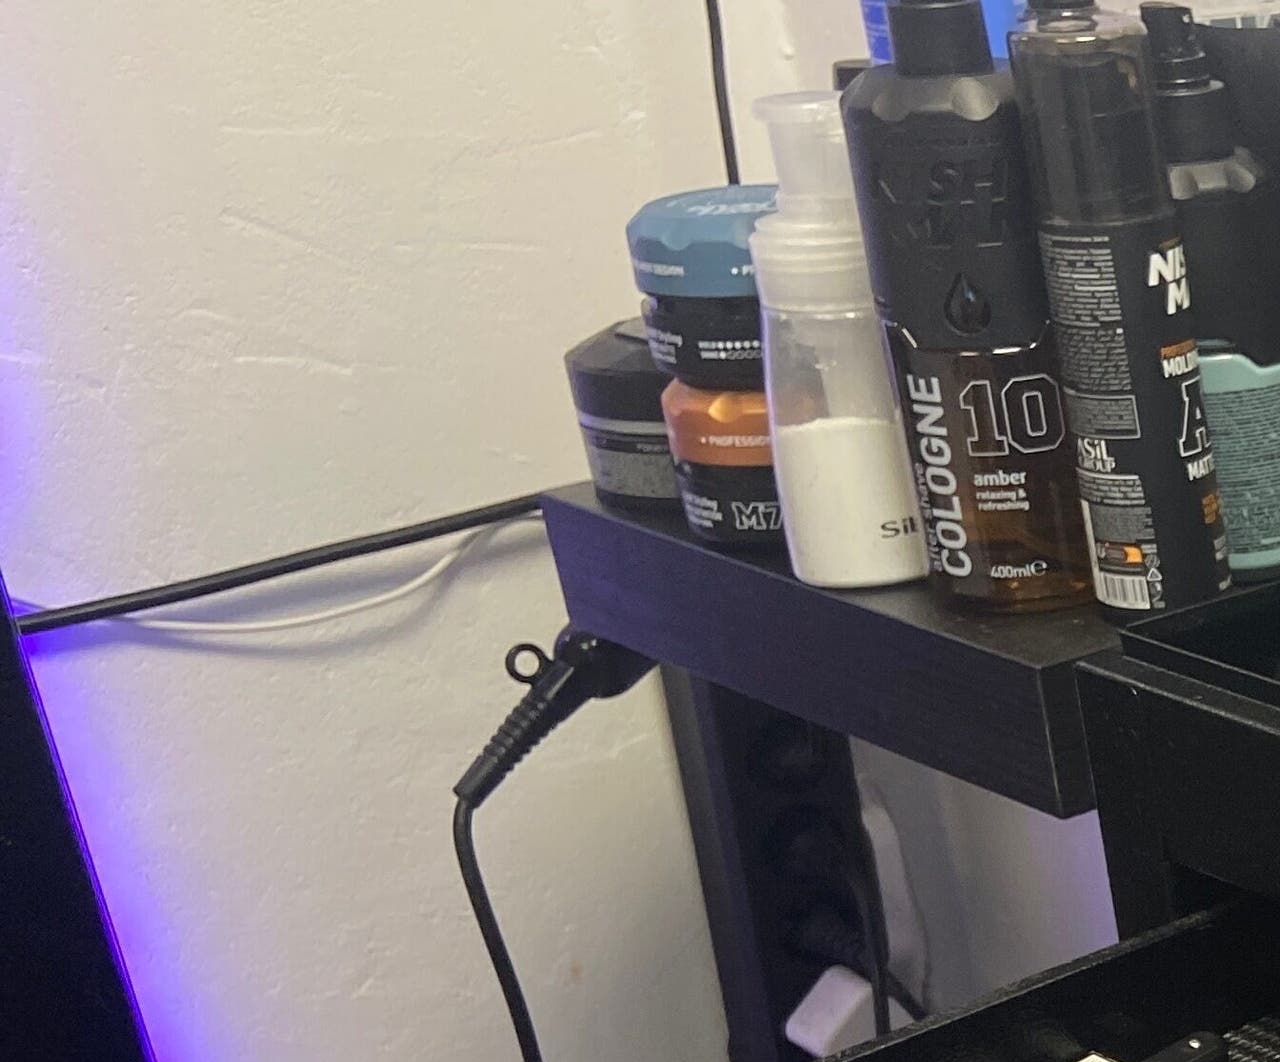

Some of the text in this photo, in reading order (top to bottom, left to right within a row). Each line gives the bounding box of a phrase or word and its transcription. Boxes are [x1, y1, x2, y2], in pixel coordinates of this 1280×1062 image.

[959, 373, 1066, 457] 10
[907, 373, 973, 577] COLOGNE
[973, 470, 1027, 487] amber
[975, 489, 1016, 500] relaxing
[978, 499, 1030, 512] refreshing
